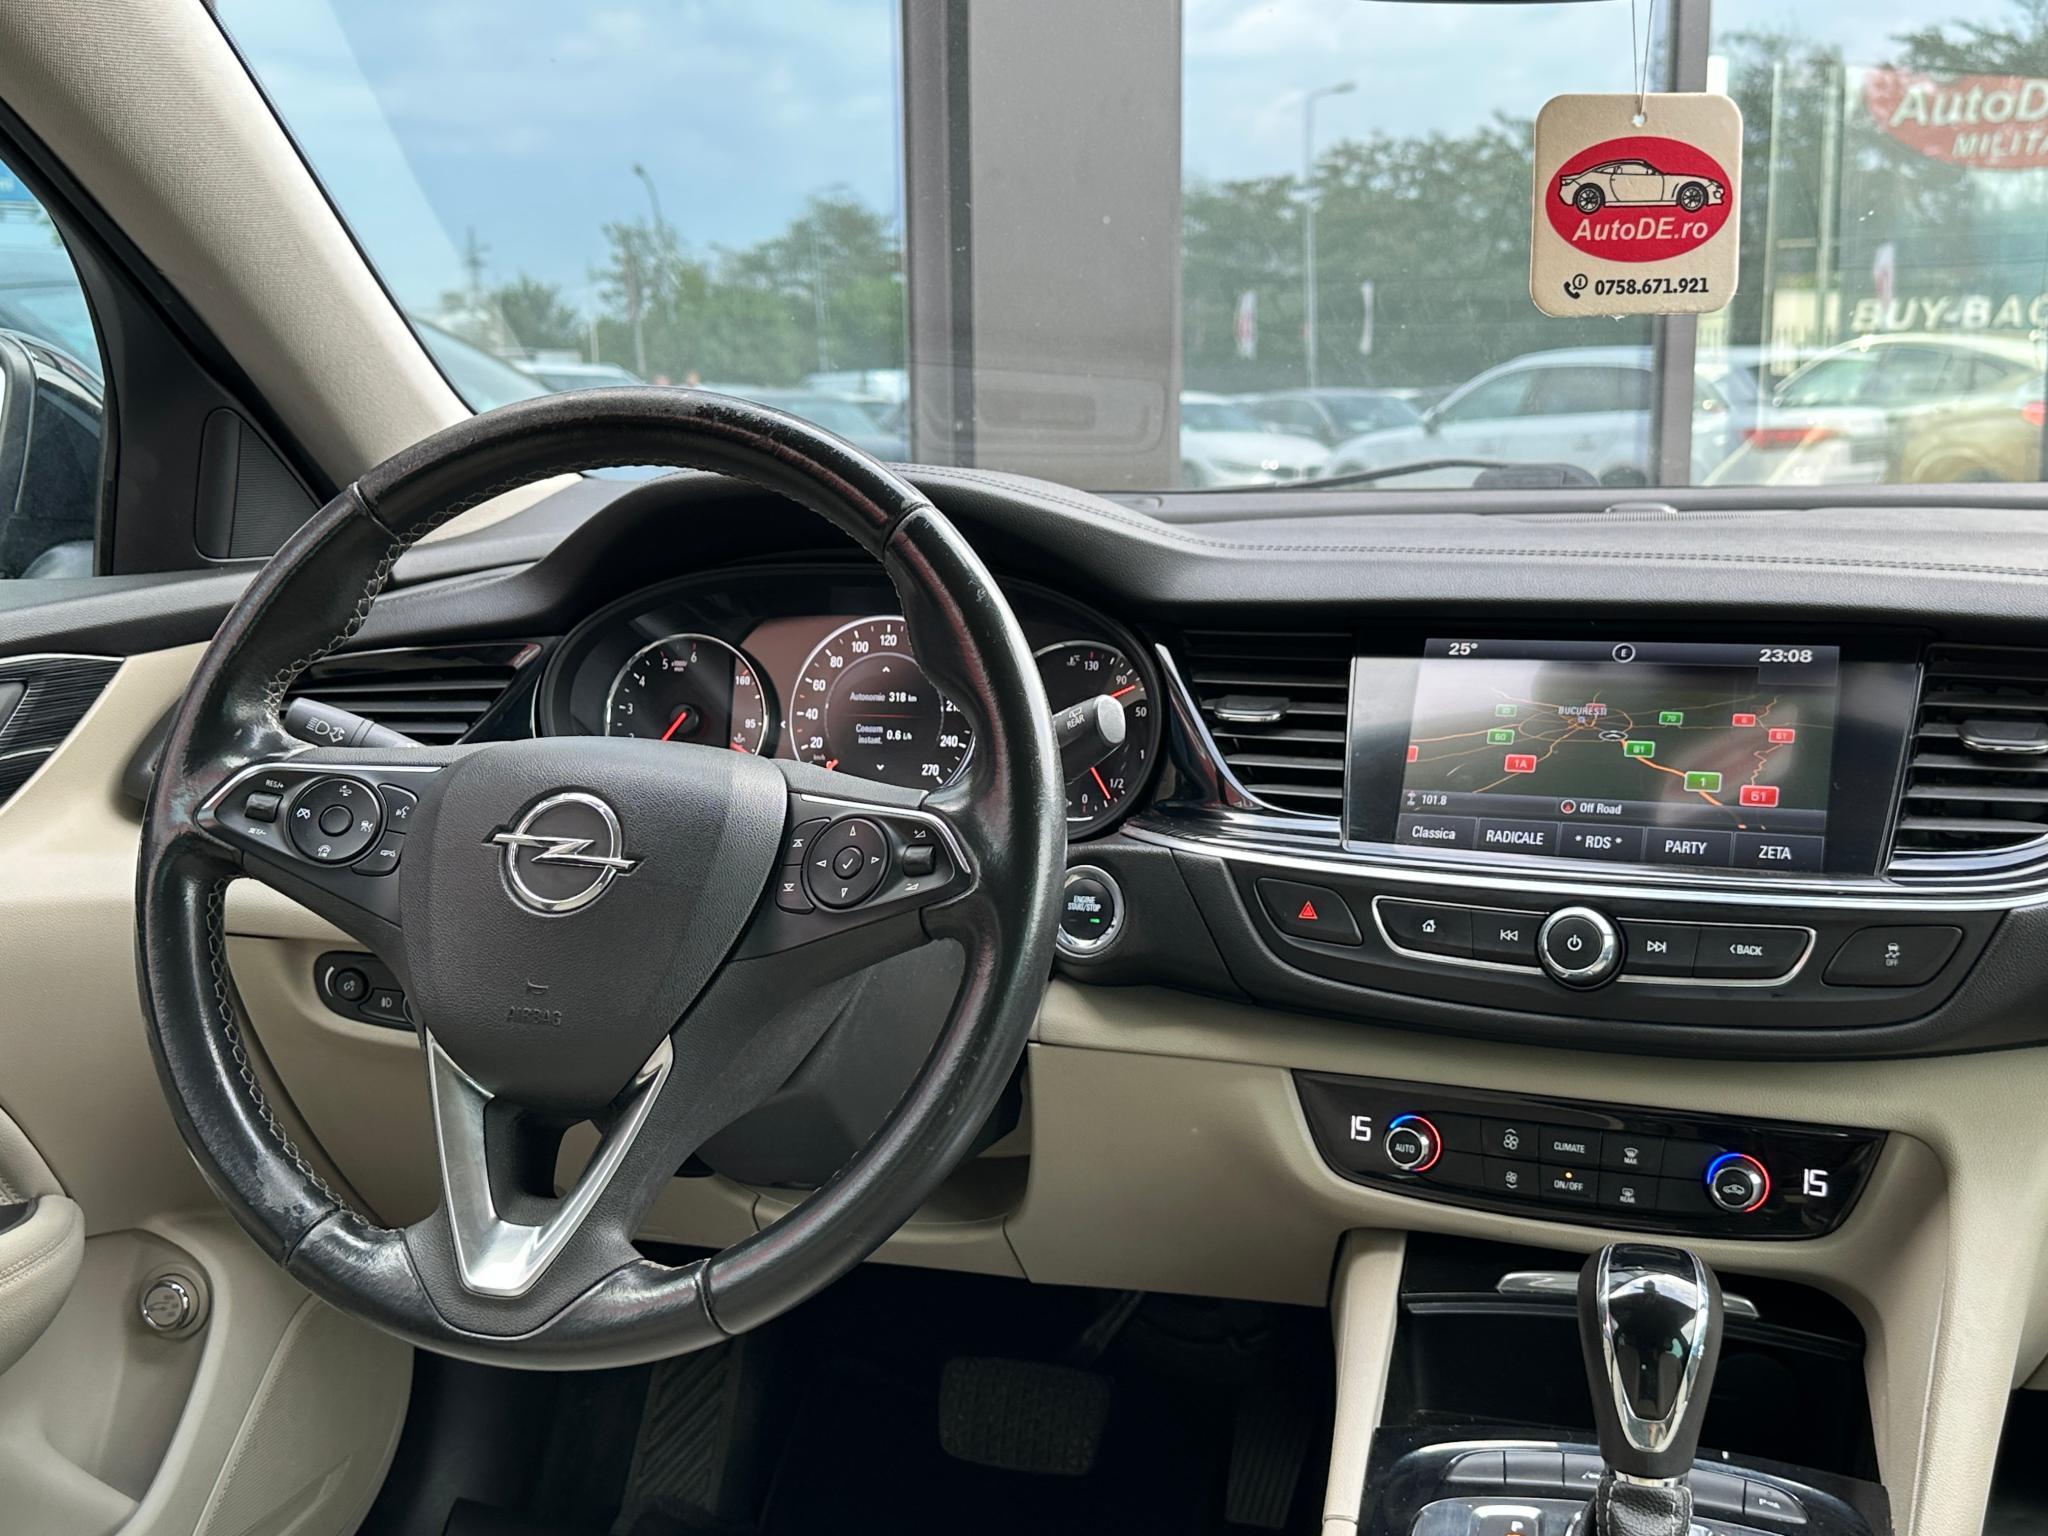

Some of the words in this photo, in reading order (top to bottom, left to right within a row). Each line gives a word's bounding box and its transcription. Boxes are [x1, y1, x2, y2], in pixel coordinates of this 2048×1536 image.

[1572, 217, 1709, 242] AutoDE.ro
[1594, 278, 1709, 296] 0758.671.921
[880, 634, 897, 646] 120
[851, 641, 869, 653] 100
[1448, 642, 1478, 656] 25°
[690, 651, 698, 663] 6
[830, 656, 843, 668] 80
[1758, 648, 1813, 664] 23:08
[662, 658, 669, 670] 5
[1084, 660, 1099, 671] 130
[638, 675, 646, 687] 4
[735, 675, 750, 686] 160
[812, 680, 826, 691] 60
[1115, 675, 1128, 685] 90
[888, 692, 907, 702] 318
[627, 703, 634, 714] 3
[805, 708, 818, 720] 40
[1135, 707, 1147, 717] 50
[745, 718, 757, 729] 95
[855, 723, 884, 734] Consum
[1066, 717, 1085, 730] REAR
[886, 729, 902, 741] 0.6
[810, 737, 823, 749] 20
[940, 736, 959, 748] 240
[1139, 749, 1145, 760] 1
[1514, 757, 1528, 769] 1A
[921, 764, 939, 776] 270
[1110, 778, 1124, 788] 1/2
[1700, 777, 1706, 787] 1
[1081, 793, 1088, 804] 0
[1421, 794, 1447, 806] 101.8
[1751, 790, 1766, 802] 61
[1579, 802, 1594, 813] Off
[1597, 804, 1623, 815] Road
[1411, 825, 1456, 841] Classica
[1485, 829, 1545, 846] RADICALE
[1664, 840, 1707, 855] PARTY
[1758, 845, 1793, 860] ZETA
[1073, 895, 1096, 904] ENGINE
[1067, 902, 1101, 912] START/STOP
[1886, 959, 1899, 967] OFF
[1350, 1114, 1372, 1142] 15
[1394, 1143, 1415, 1154] AUTO
[1553, 1141, 1585, 1153] CLIMATE
[1553, 1179, 1584, 1191] ON/OFF
[1803, 1168, 1829, 1197] 15
